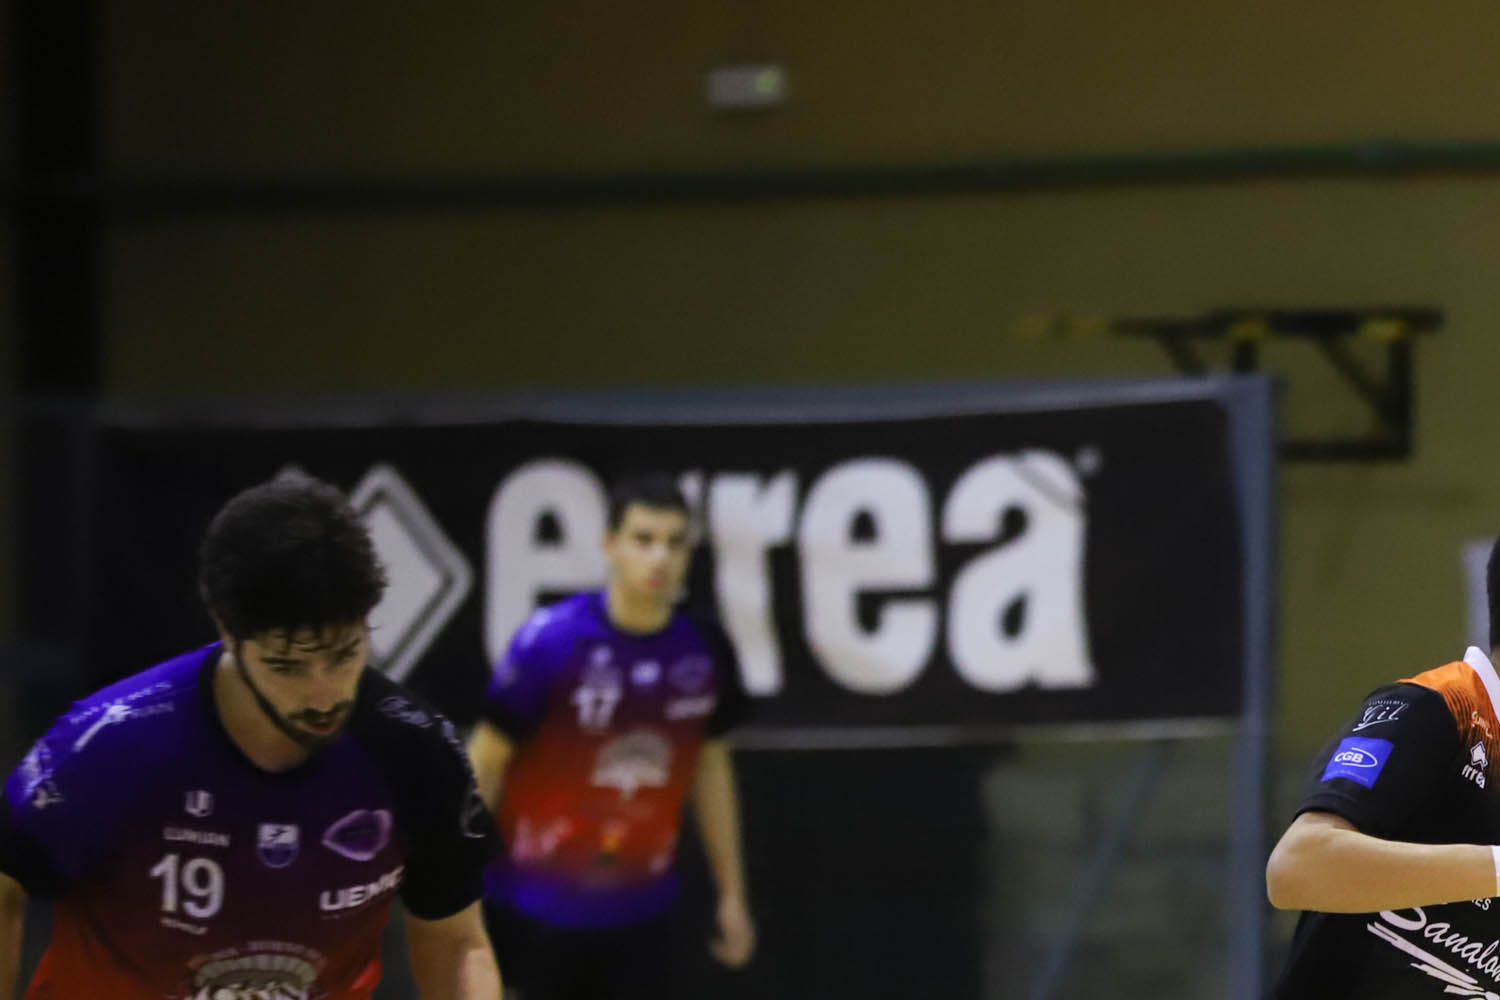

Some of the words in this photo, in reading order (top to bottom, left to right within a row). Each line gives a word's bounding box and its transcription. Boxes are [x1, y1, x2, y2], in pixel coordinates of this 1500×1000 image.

[484, 449, 1096, 696] erea
[1334, 751, 1364, 763] CGB
[150, 853, 225, 919] 19
